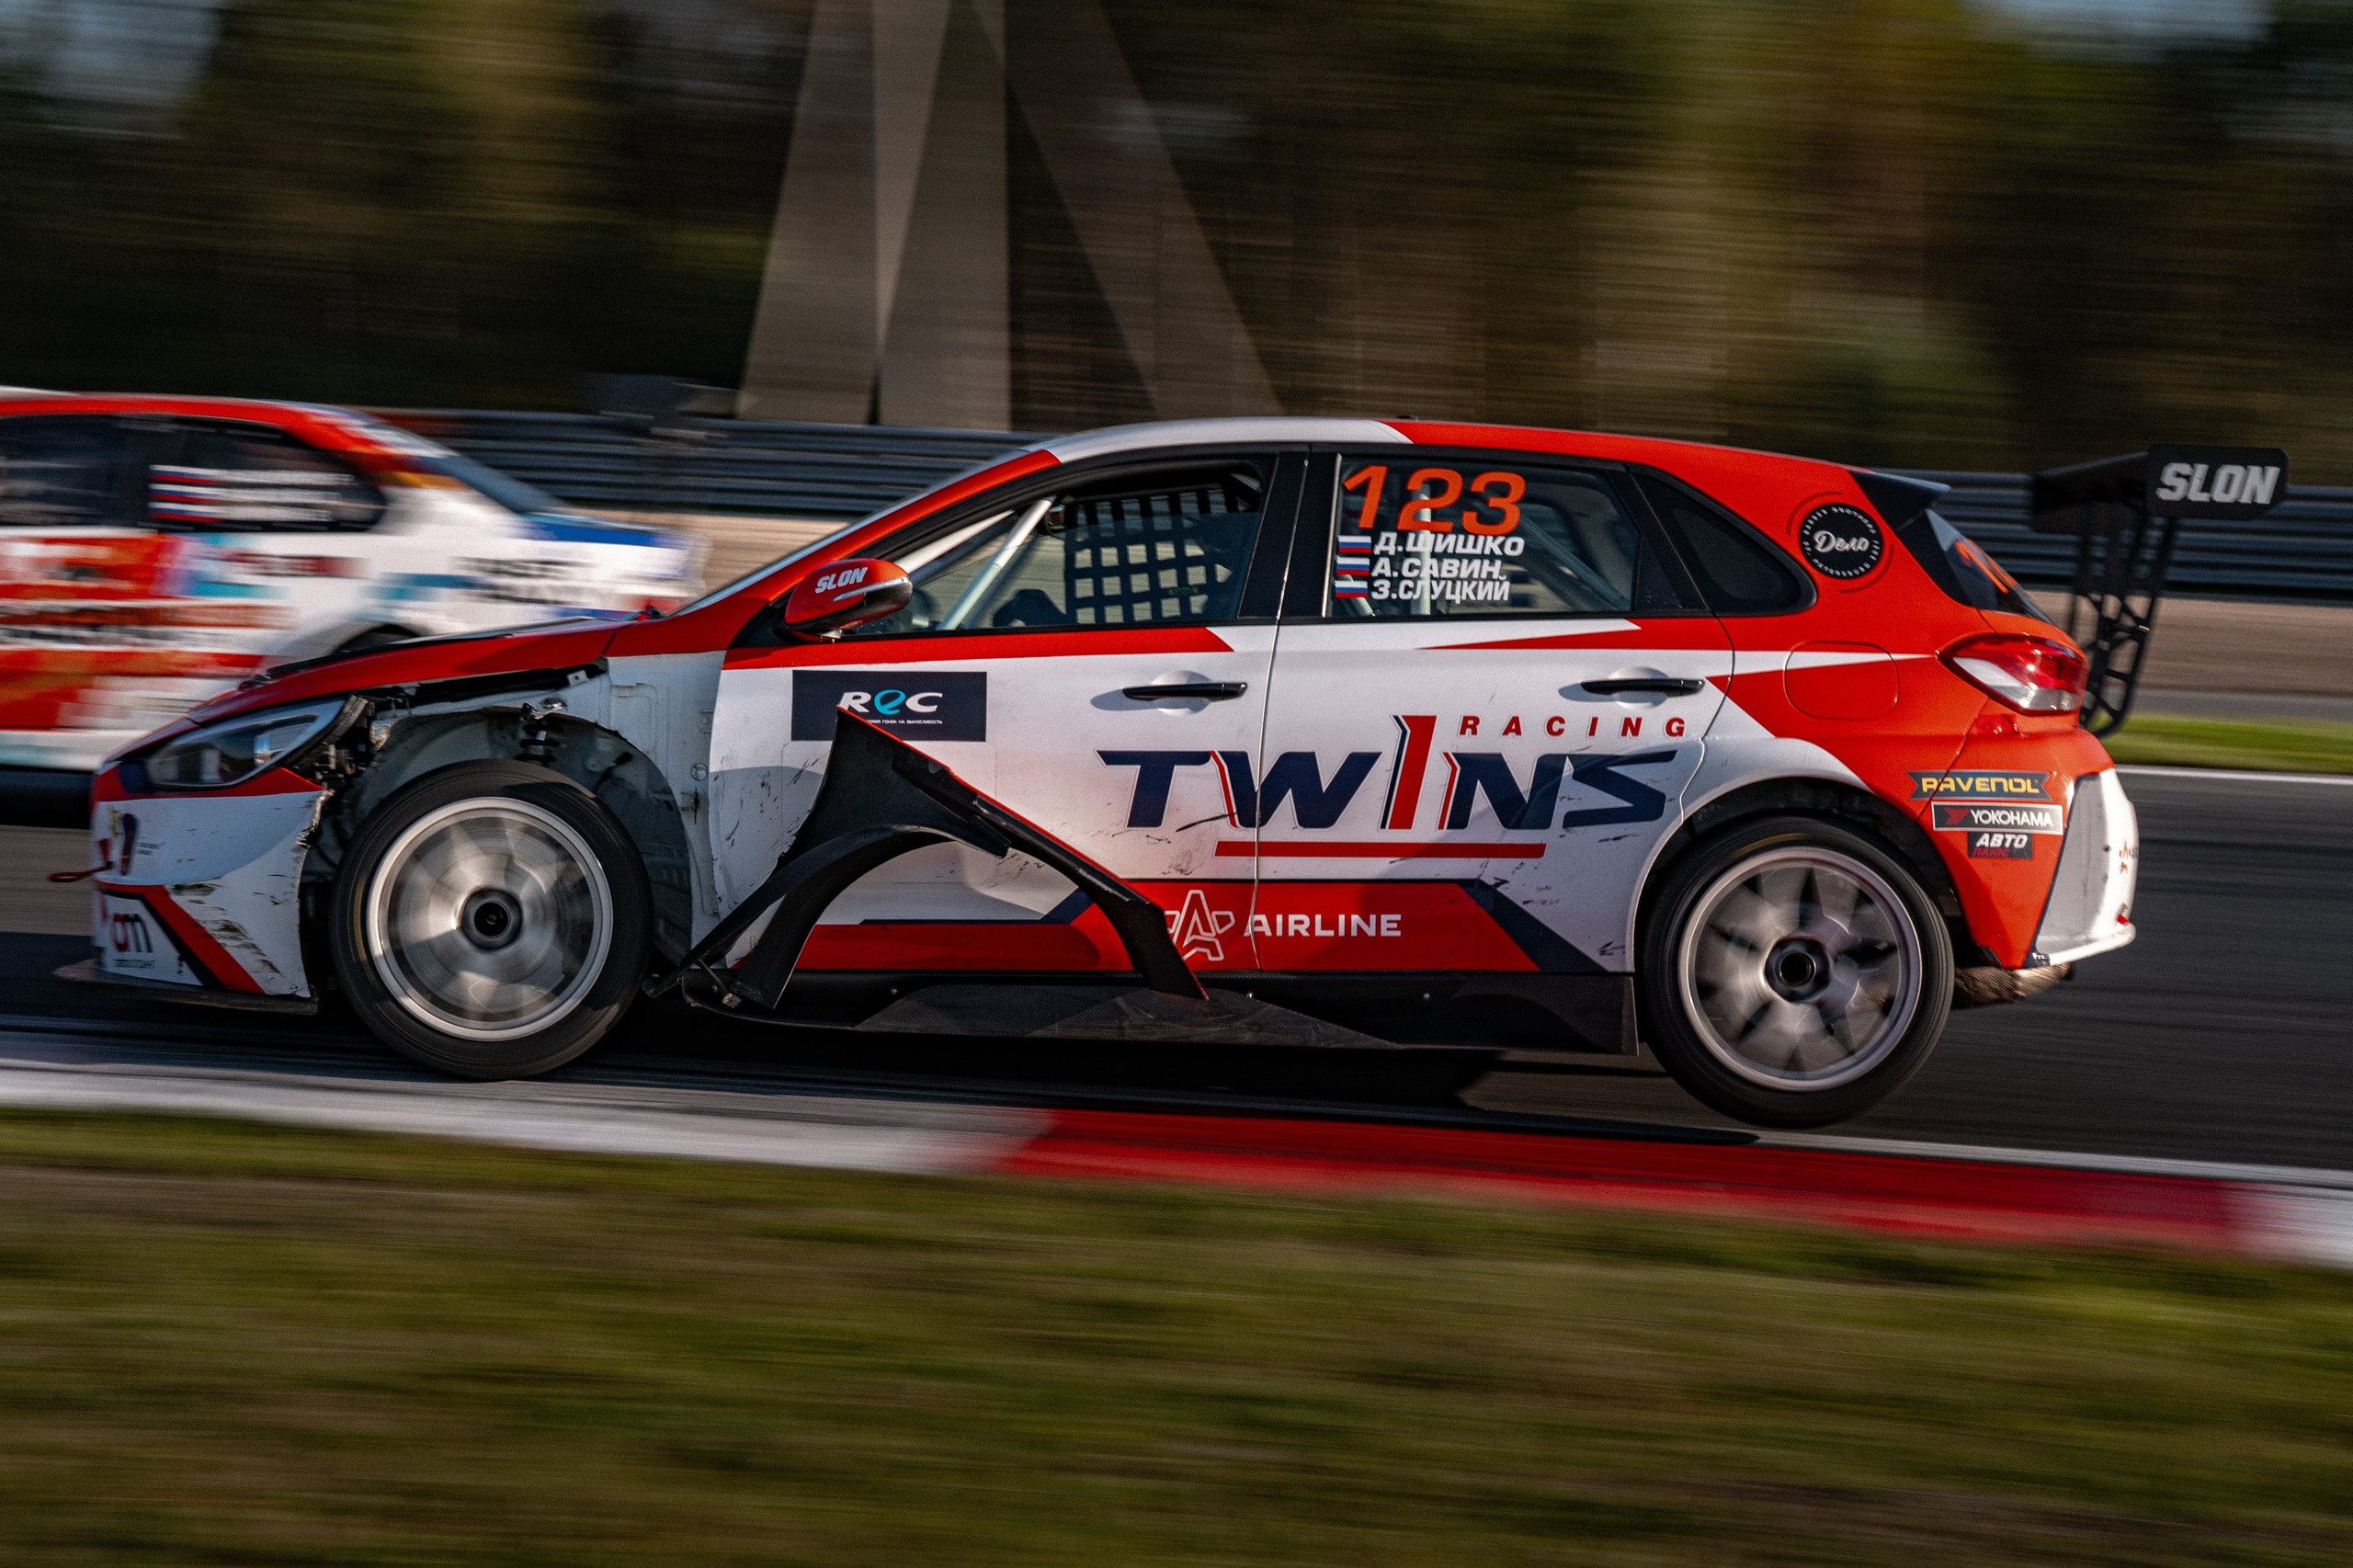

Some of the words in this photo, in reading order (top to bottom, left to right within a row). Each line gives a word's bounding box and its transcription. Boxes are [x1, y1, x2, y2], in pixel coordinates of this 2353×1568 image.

[2155, 462, 2280, 505] SLON
[1343, 465, 1526, 536] 123
[1374, 531, 1525, 556] Д.ШИШКО
[814, 566, 868, 594] SLON
[1370, 574, 1510, 603] З.СЛУЦКИЙ
[1460, 716, 1686, 737] RACING
[1096, 715, 1678, 830] TWINS
[1922, 778, 2040, 793] RAVENOL
[1971, 810, 2053, 827] YOKOHAMA
[1976, 833, 2028, 848] АВТО
[1244, 914, 1403, 937] AIRLINE
